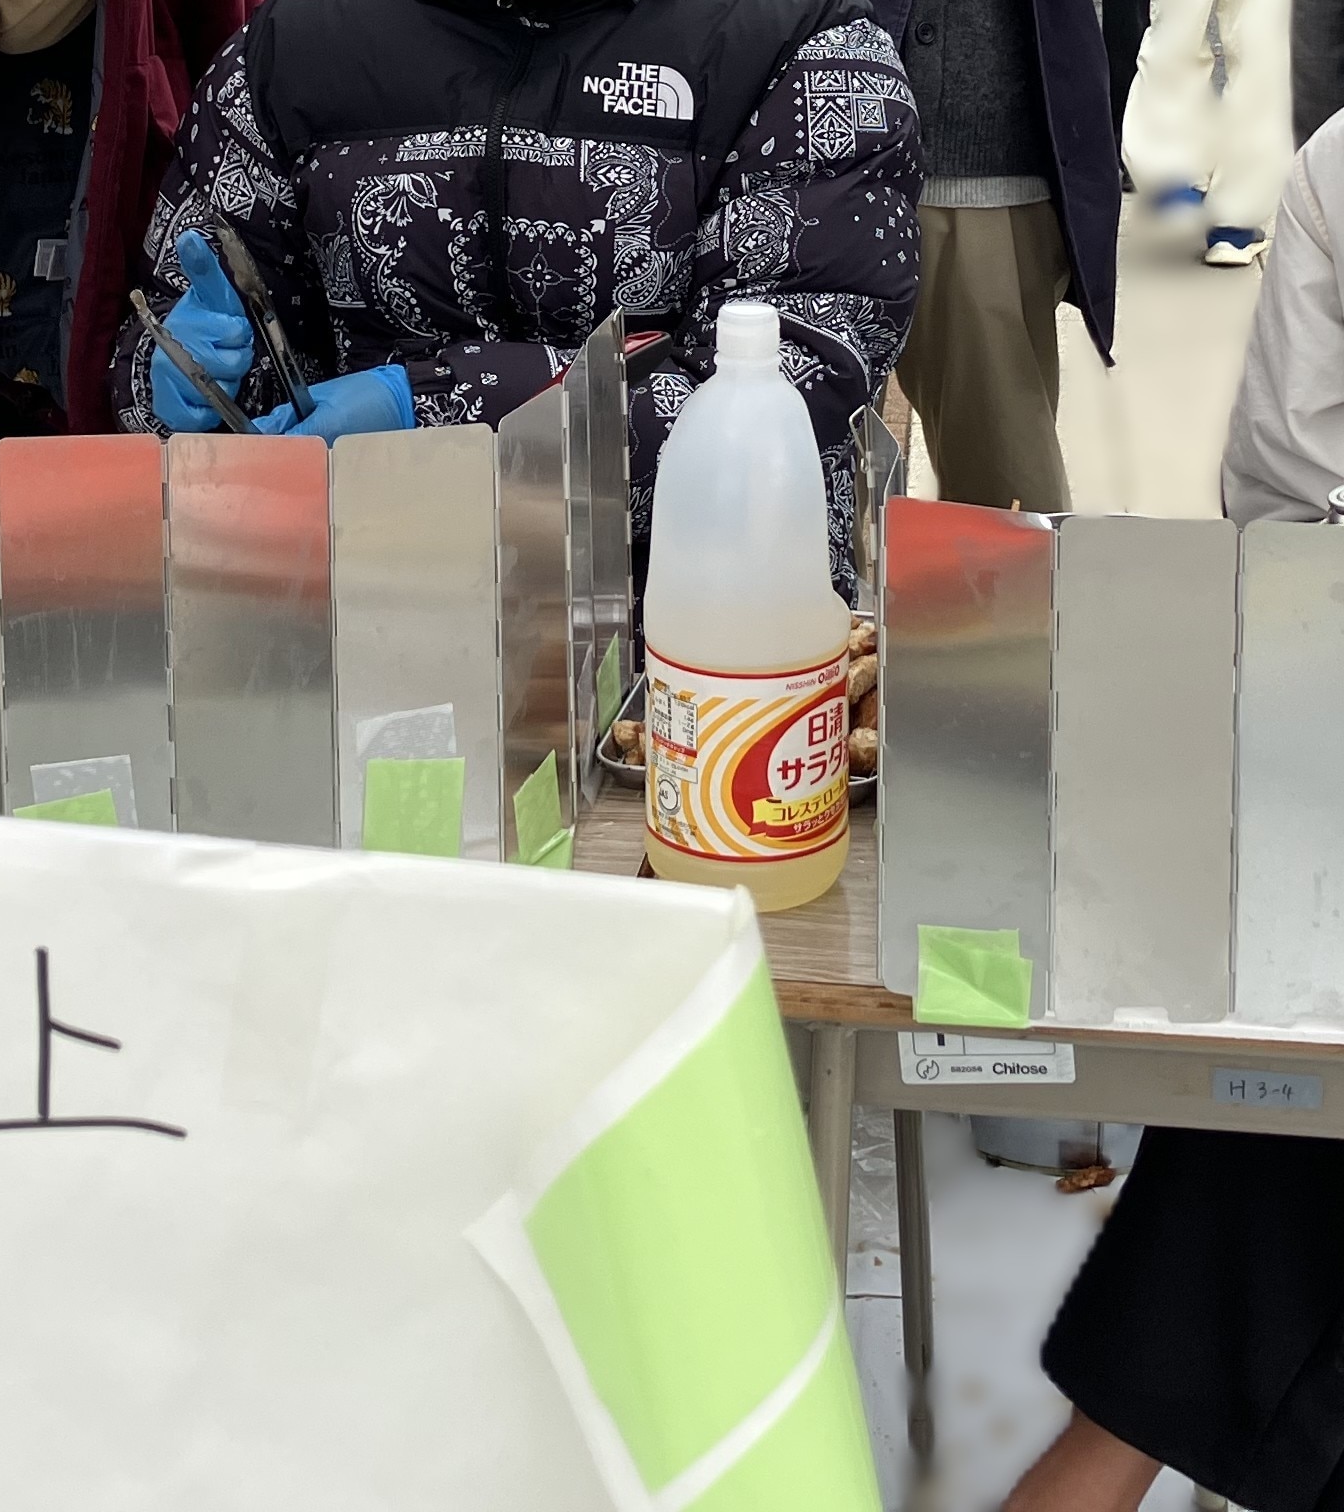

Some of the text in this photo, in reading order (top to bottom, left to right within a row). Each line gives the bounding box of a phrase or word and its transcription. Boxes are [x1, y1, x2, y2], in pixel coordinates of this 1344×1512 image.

[617, 62, 659, 82] THE
[582, 76, 657, 100] NORTH
[603, 94, 657, 117] FACE
[808, 702, 844, 747] 日清
[992, 1062, 1048, 1076] Chitose
[1229, 1080, 1245, 1100] H
